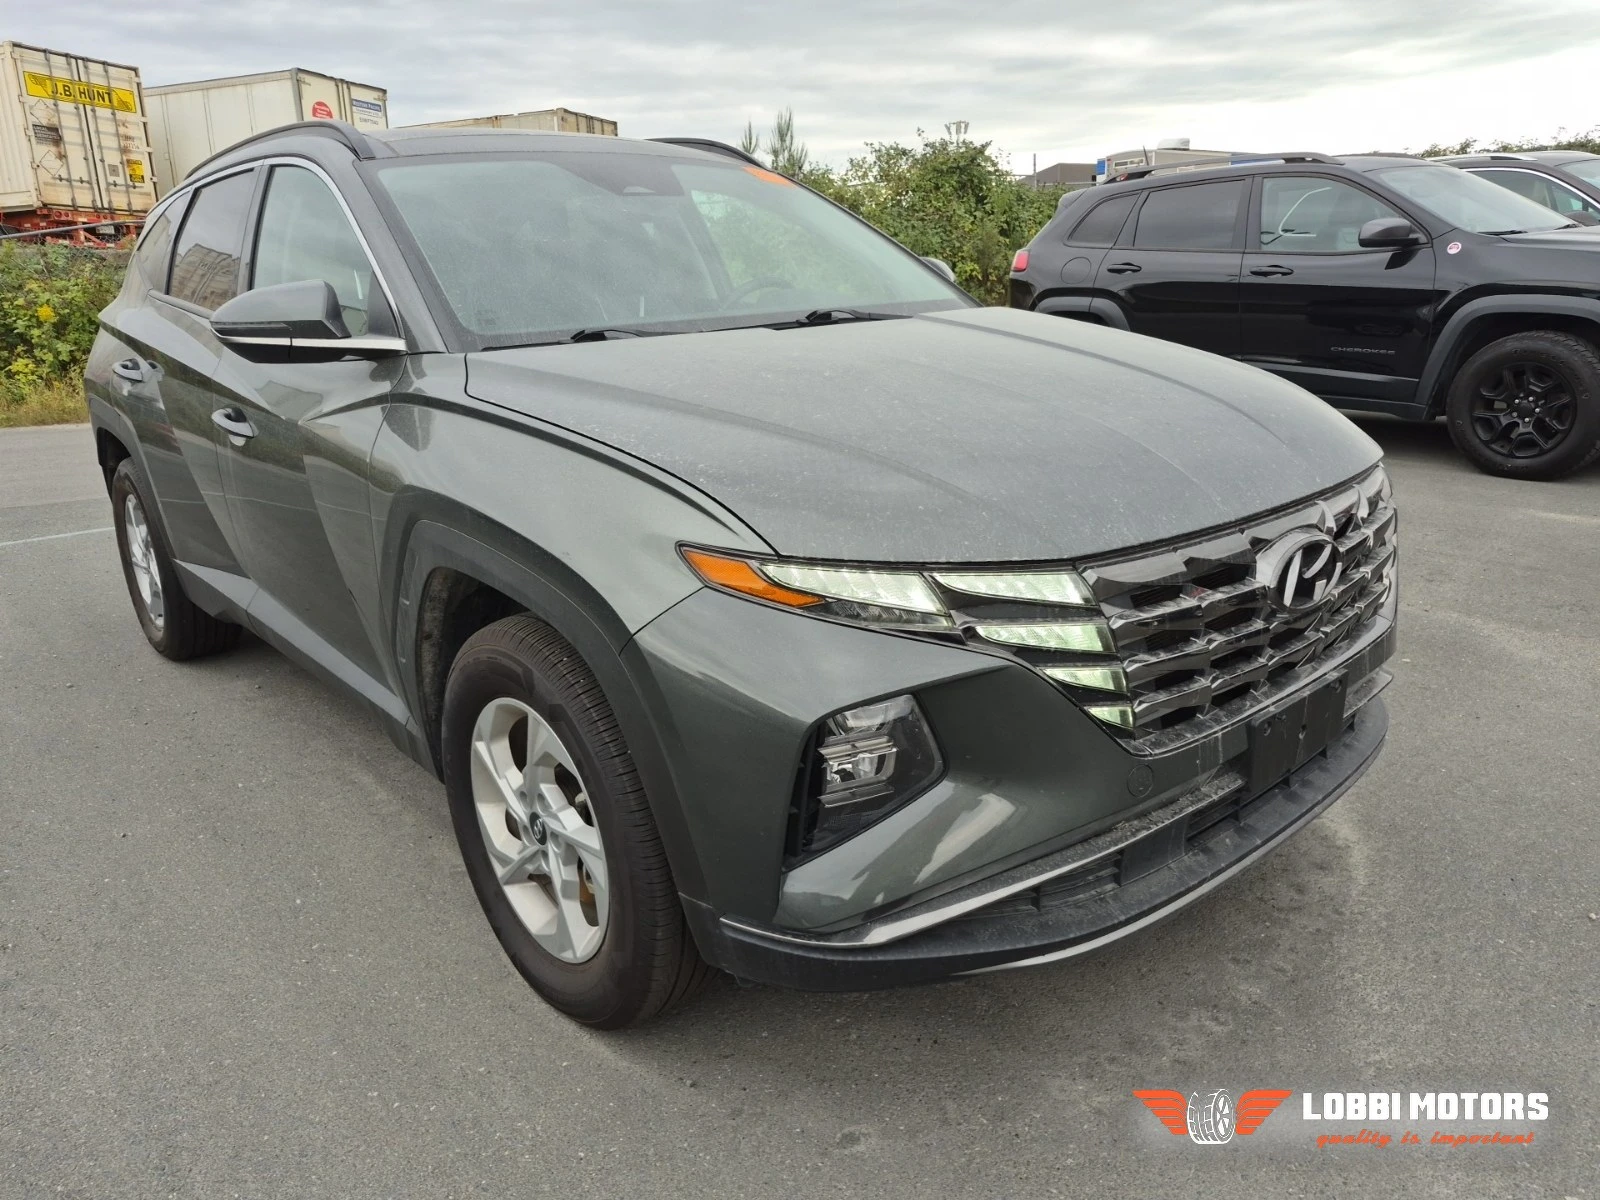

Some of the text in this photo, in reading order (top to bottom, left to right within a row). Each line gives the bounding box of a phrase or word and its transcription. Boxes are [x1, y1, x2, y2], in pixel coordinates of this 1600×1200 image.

[51, 82, 113, 105] J.B. HUNT
[1330, 346, 1396, 355] CHEROKEE
